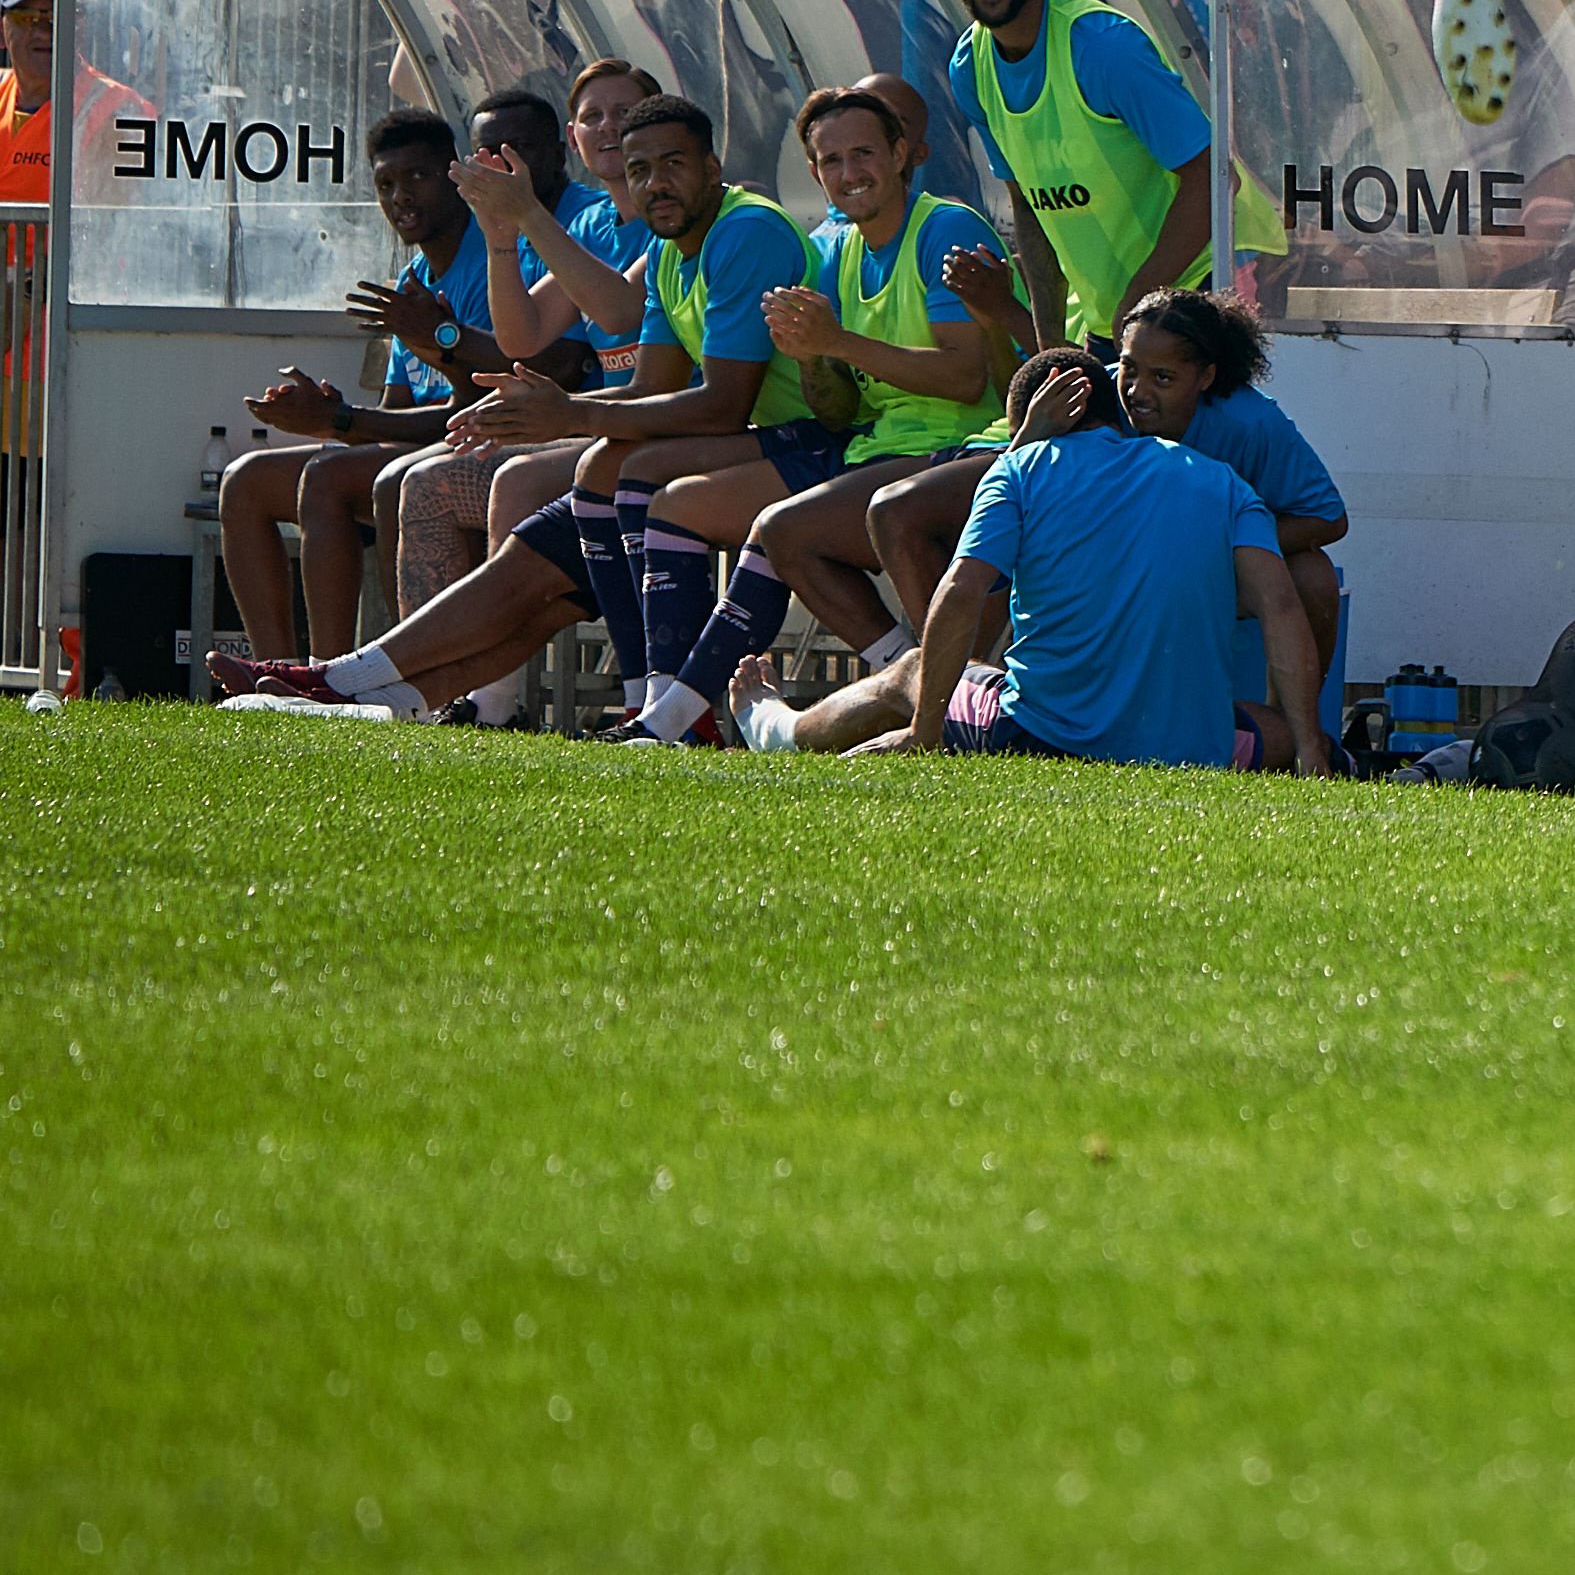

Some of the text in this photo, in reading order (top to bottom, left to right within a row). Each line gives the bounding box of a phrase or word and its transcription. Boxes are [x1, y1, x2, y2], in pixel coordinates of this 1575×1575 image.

[13, 151, 50, 166] DHFC
[1031, 183, 1091, 212] JAKO
[1284, 163, 1525, 237] HOME
[178, 639, 252, 657] DIOND
